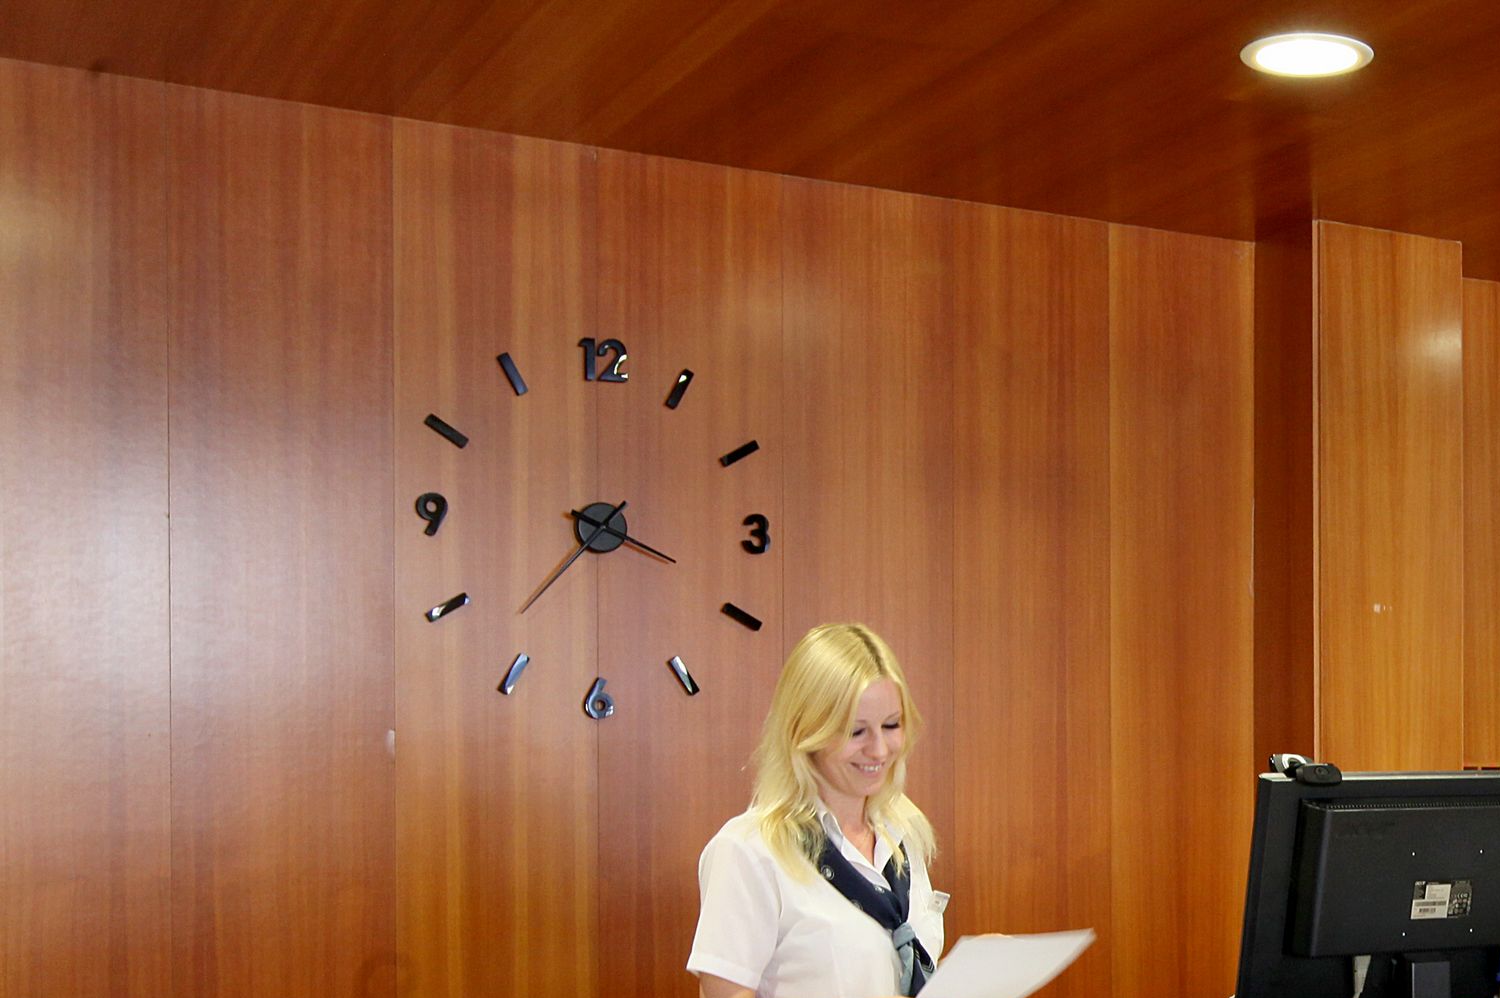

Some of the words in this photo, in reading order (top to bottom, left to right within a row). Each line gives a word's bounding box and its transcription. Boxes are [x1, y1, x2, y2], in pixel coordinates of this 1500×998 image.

[578, 337, 629, 383] 12
[415, 492, 448, 536] 9
[742, 514, 770, 554] 3
[584, 677, 614, 719] 6
